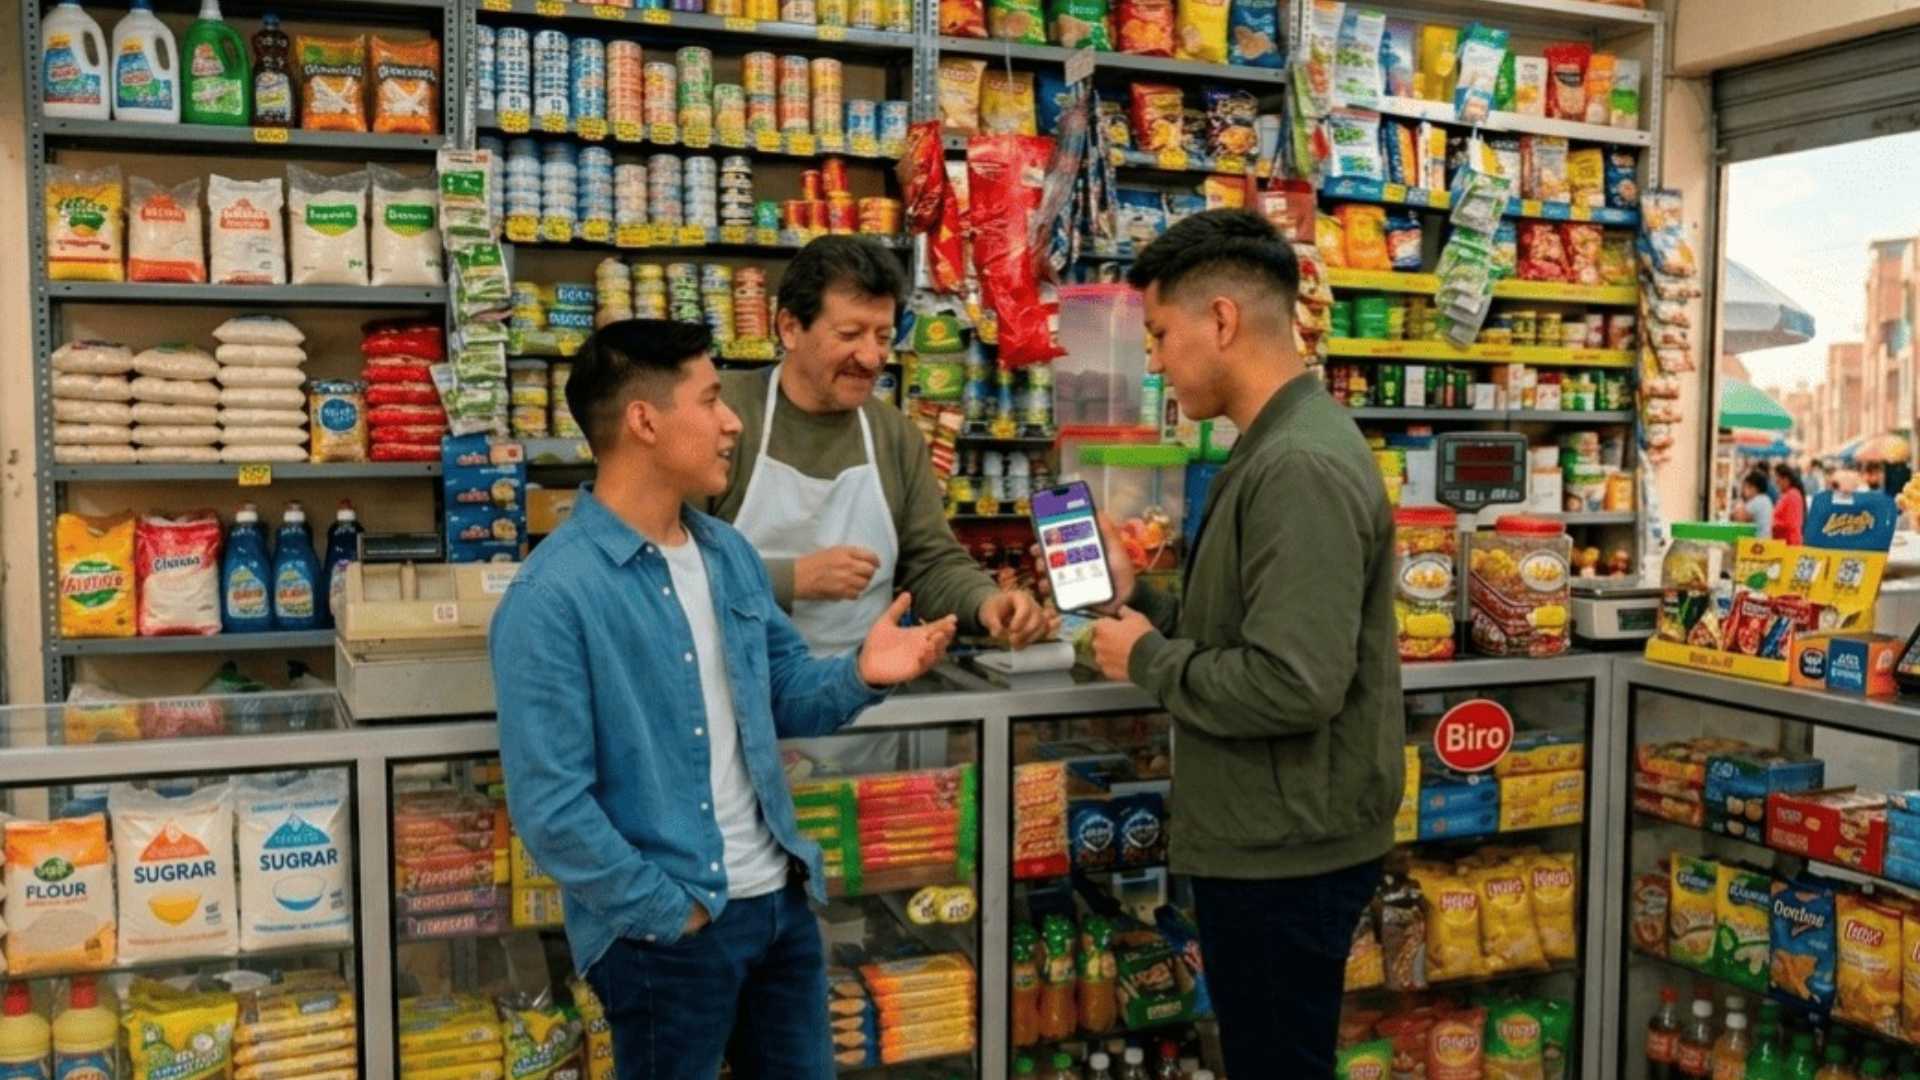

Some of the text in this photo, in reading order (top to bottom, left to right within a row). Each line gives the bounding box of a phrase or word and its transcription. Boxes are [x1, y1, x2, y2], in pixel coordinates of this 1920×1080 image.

[1445, 722, 1505, 753] Biro
[259, 849, 339, 871] SUGRAR
[133, 860, 217, 884] SUGRAR
[26, 881, 87, 899] FLOUR
